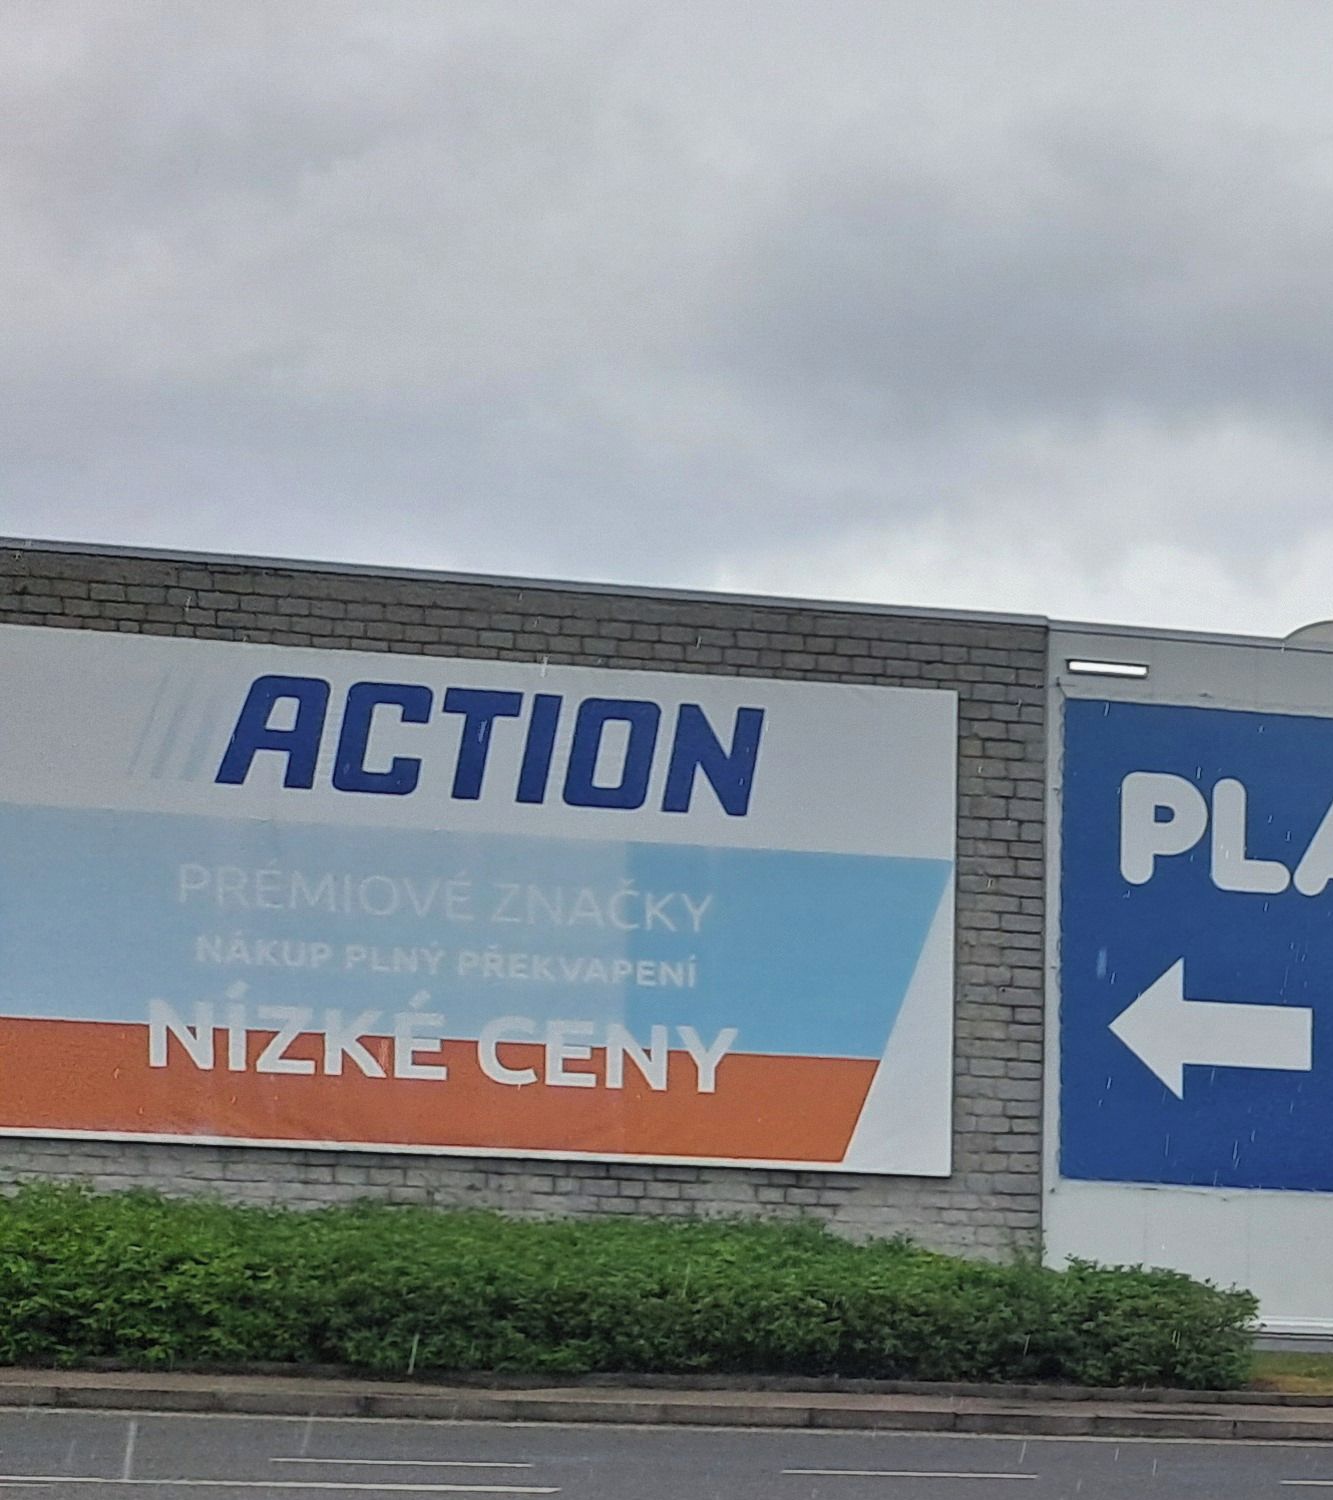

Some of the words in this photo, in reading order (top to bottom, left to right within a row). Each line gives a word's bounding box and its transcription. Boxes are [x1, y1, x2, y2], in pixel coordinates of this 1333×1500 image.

[215, 674, 766, 816] ACTION
[178, 858, 475, 921] PRÉMIOVÉ
[491, 878, 713, 932] ZNAČKY
[197, 930, 332, 968] NÁKUP
[345, 941, 445, 976] PLNÝ
[458, 944, 697, 988] PŘEKVAPENÍ
[148, 980, 448, 1079] NÍZKÉ
[478, 1015, 738, 1093] CENY
